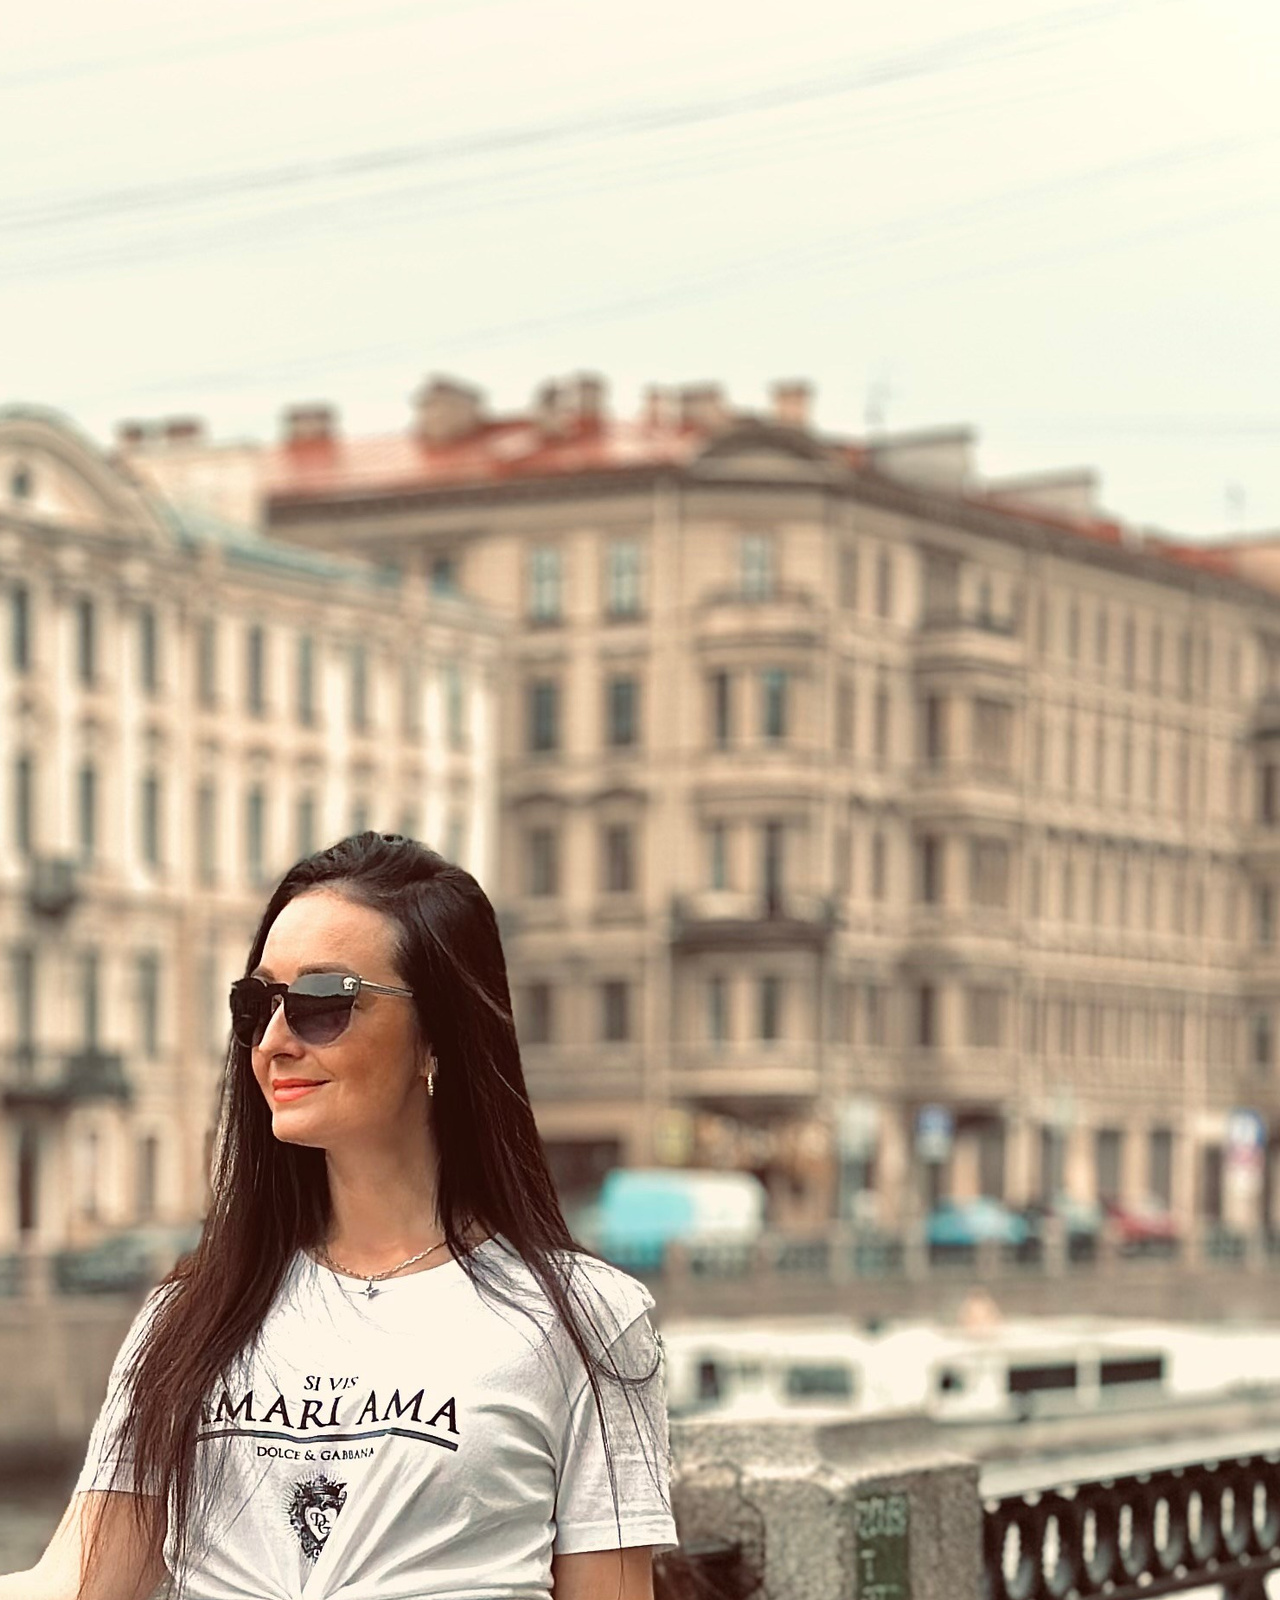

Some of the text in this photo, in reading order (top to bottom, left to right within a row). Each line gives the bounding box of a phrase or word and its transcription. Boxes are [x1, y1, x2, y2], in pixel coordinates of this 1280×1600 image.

[304, 1375, 359, 1391] SI VIS
[355, 1388, 460, 1435] AMA
[257, 1446, 375, 1461] DOLCE & GABBANA
